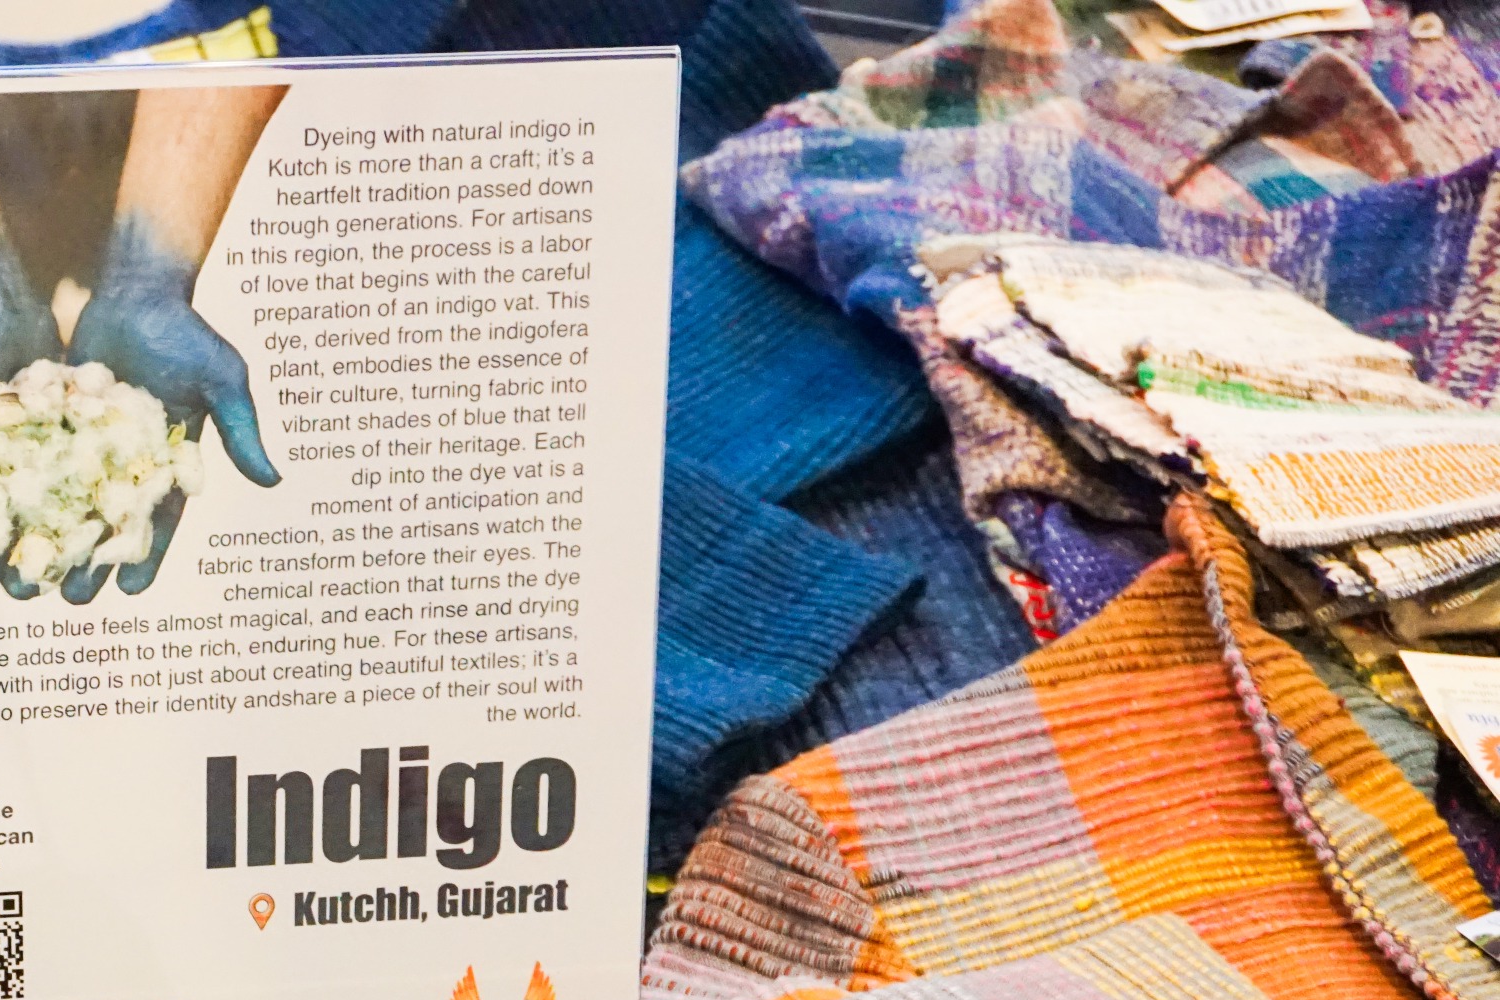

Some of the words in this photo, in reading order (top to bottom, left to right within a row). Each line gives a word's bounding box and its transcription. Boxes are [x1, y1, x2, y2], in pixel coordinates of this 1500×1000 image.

[304, 126, 376, 152] Dyeing
[383, 124, 425, 144] with
[432, 121, 502, 142] natural
[510, 119, 571, 143] indigo
[578, 117, 595, 136] in
[276, 184, 362, 206] heartfelt
[367, 182, 450, 203] tradition
[457, 177, 532, 204] passed
[538, 177, 593, 196] down
[250, 215, 329, 240] through
[335, 211, 463, 238] generations.
[472, 208, 506, 228] For
[512, 206, 593, 226] artisans
[240, 274, 260, 294] of
[267, 274, 309, 293] love
[315, 272, 355, 291] that
[361, 269, 429, 293] begins
[435, 266, 476, 286] with
[483, 265, 515, 284] the
[521, 262, 591, 283] careful
[254, 300, 371, 327] preparation
[377, 297, 397, 318] of
[403, 301, 428, 316] an
[436, 295, 497, 318] indigo
[503, 293, 540, 312] vat.
[546, 291, 590, 310] This
[264, 331, 307, 354] dye,
[314, 326, 390, 348] derived
[397, 326, 443, 344] from
[450, 324, 481, 342] the
[488, 319, 589, 344] indigofera
[269, 359, 325, 383] plant,
[332, 354, 433, 376] embodies
[439, 352, 471, 371] the
[477, 352, 562, 370] essence
[569, 346, 589, 366] of
[278, 386, 324, 406] their
[329, 384, 404, 404] culture,
[411, 380, 481, 403] turning
[488, 377, 545, 397] fabric
[551, 376, 587, 394] into
[281, 414, 351, 434] vibrant
[357, 410, 432, 431] shades
[438, 408, 457, 428] of
[464, 407, 507, 426] blue
[513, 405, 551, 424] that
[558, 403, 586, 422] tell
[288, 441, 356, 462] stories
[361, 439, 381, 458] of
[388, 438, 432, 457] their
[439, 435, 526, 457] heritage.
[535, 431, 585, 451] Each
[208, 526, 325, 548] connection,
[332, 527, 356, 542] as
[361, 522, 394, 541] the
[400, 520, 480, 539] artisans
[486, 515, 545, 535] watch
[551, 514, 582, 532] the
[197, 556, 253, 576] fabric
[259, 552, 355, 573] transform
[362, 549, 427, 568] before
[432, 545, 477, 565] their
[483, 546, 536, 566] eyes.
[543, 541, 581, 559] The
[223, 580, 313, 602] chemical
[320, 577, 400, 597] reaction
[407, 575, 445, 593] that
[450, 575, 501, 591] turns
[507, 570, 538, 588] the
[544, 569, 581, 590] dye
[26, 622, 45, 639] to
[52, 619, 95, 638] blue
[101, 616, 150, 635] feels
[156, 613, 224, 633] almost
[230, 608, 313, 632] magical,
[321, 605, 358, 625] and
[364, 602, 413, 622] each
[420, 601, 469, 620] rinse
[475, 598, 512, 617] and
[518, 596, 579, 618] drying
[16, 647, 66, 667] adds
[72, 644, 129, 667] depth
[136, 644, 155, 661] to
[161, 641, 193, 659] the
[200, 638, 241, 658] rich,
[248, 634, 336, 656] enduring
[343, 632, 386, 650] hue.
[394, 629, 427, 648] For
[433, 627, 488, 646] these
[494, 624, 578, 643] artisans,
[40, 673, 101, 695] indigo
[108, 671, 124, 689] is
[131, 669, 162, 688] not
[167, 667, 204, 691] just
[210, 664, 267, 684] about
[272, 660, 353, 682] creating
[359, 654, 444, 676] beautiful
[450, 652, 526, 671] textiles;
[566, 651, 578, 666] a
[20, 702, 108, 725] preserve
[114, 696, 159, 715] their
[166, 692, 237, 714] identity
[243, 689, 337, 709] andshare
[344, 690, 356, 704] a
[362, 685, 416, 707] piece
[422, 681, 442, 700] of
[447, 679, 491, 698] their
[497, 676, 537, 696] soul
[543, 675, 583, 693] with
[486, 705, 517, 723] the
[523, 701, 581, 720] world.
[206, 745, 576, 870] Indigo
[294, 885, 428, 927] Kutchh,
[436, 878, 569, 920] Gujarat
